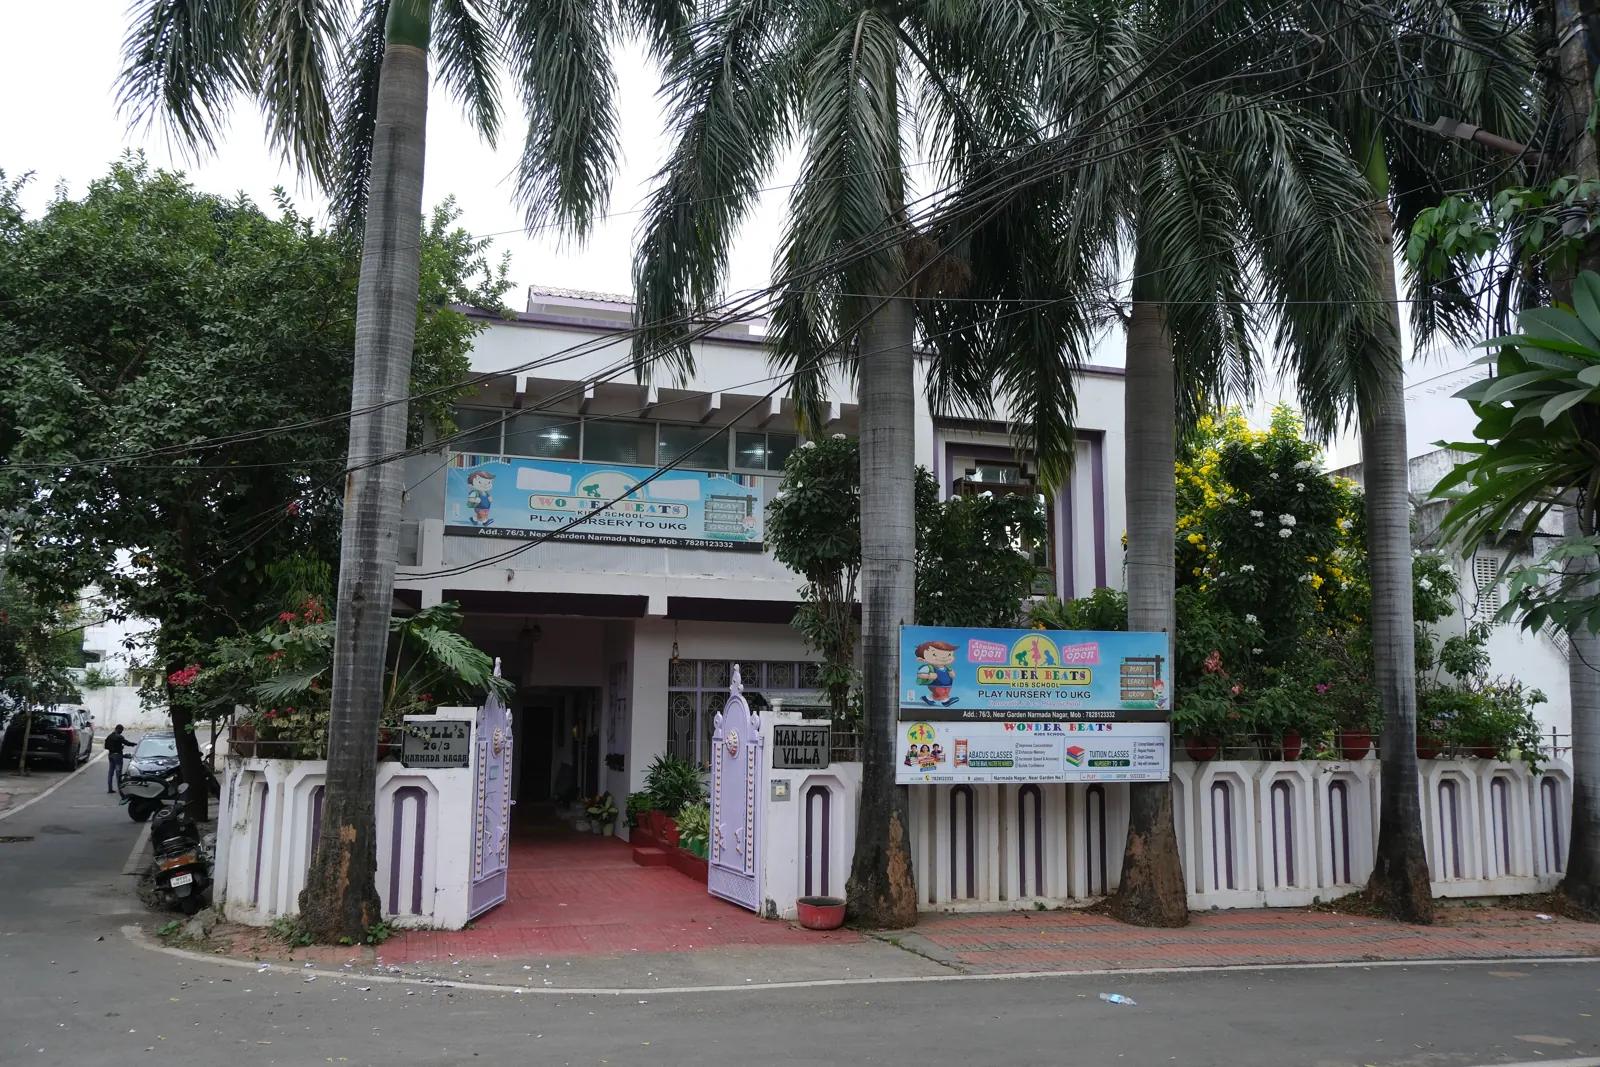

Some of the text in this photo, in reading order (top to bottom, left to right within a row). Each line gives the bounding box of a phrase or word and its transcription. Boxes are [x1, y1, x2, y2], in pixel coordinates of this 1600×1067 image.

[624, 503, 681, 515] BEATS
[604, 511, 644, 519] SCHOOL
[530, 514, 687, 531] PLAY NURSERY TO UKG
[506, 529, 527, 537] 76/3,
[588, 534, 627, 542] Narmada
[629, 535, 657, 545] Nagar,
[659, 537, 678, 545] Mob
[685, 539, 734, 548] 7828123332
[973, 649, 1002, 660] open
[1066, 651, 1094, 662] open
[983, 669, 1087, 680] WONDER BEATS
[978, 690, 1003, 698] PLAY
[1006, 690, 1052, 698] NURSERY
[1070, 691, 1091, 699] UKG
[1052, 711, 1069, 719] Nagar,
[1004, 723, 1112, 731] WONDER BEATS
[775, 730, 828, 746] MANJEET
[404, 754, 467, 762] NARMADA NAGAR
[782, 748, 820, 764] VILLA
